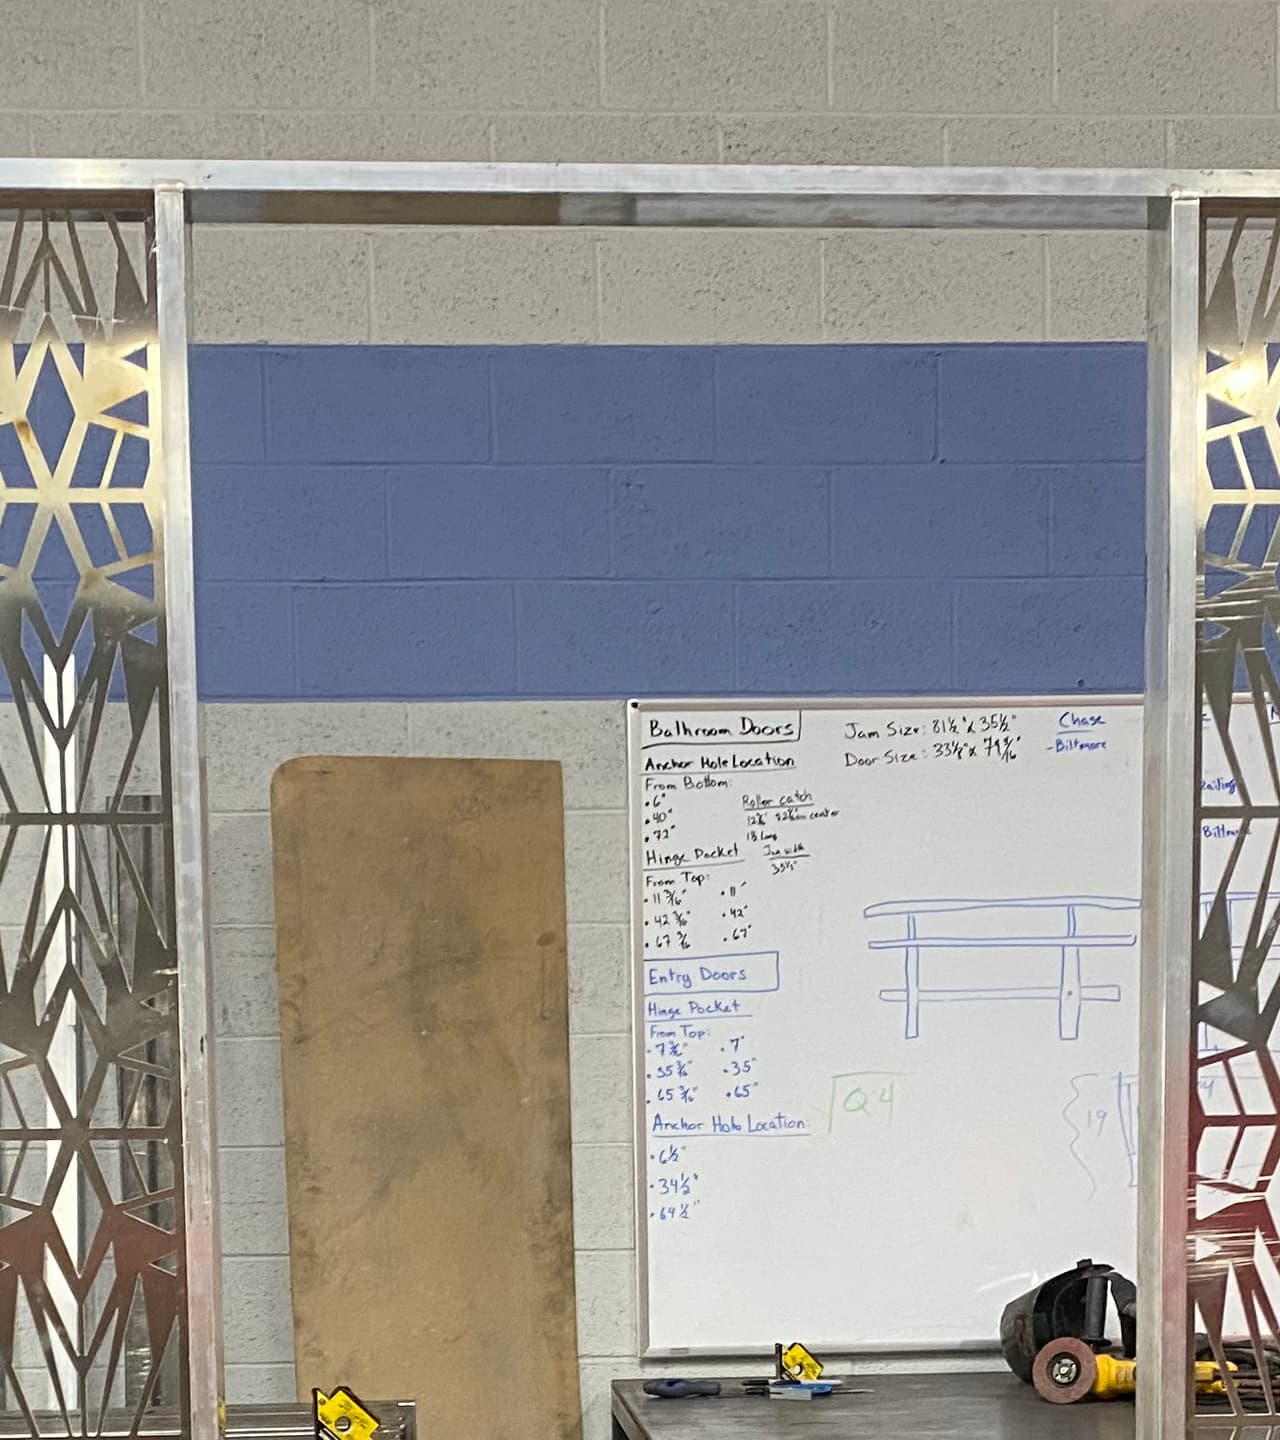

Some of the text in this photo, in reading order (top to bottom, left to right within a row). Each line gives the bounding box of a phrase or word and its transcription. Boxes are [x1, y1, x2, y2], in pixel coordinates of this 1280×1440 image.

[739, 716, 794, 736] Doors
[1059, 711, 1106, 727] Chase
[844, 722, 879, 739] Jam
[645, 752, 795, 771] Anchor Hole Location
[845, 751, 878, 767] Door
[645, 777, 677, 791] From
[646, 843, 739, 867] Hinge Pocket
[646, 876, 675, 888] From
[649, 966, 747, 989] Entry Doors
[648, 999, 741, 1018] Hinge Pocket
[650, 1025, 676, 1038] From
[652, 1113, 704, 1132] Anchor
